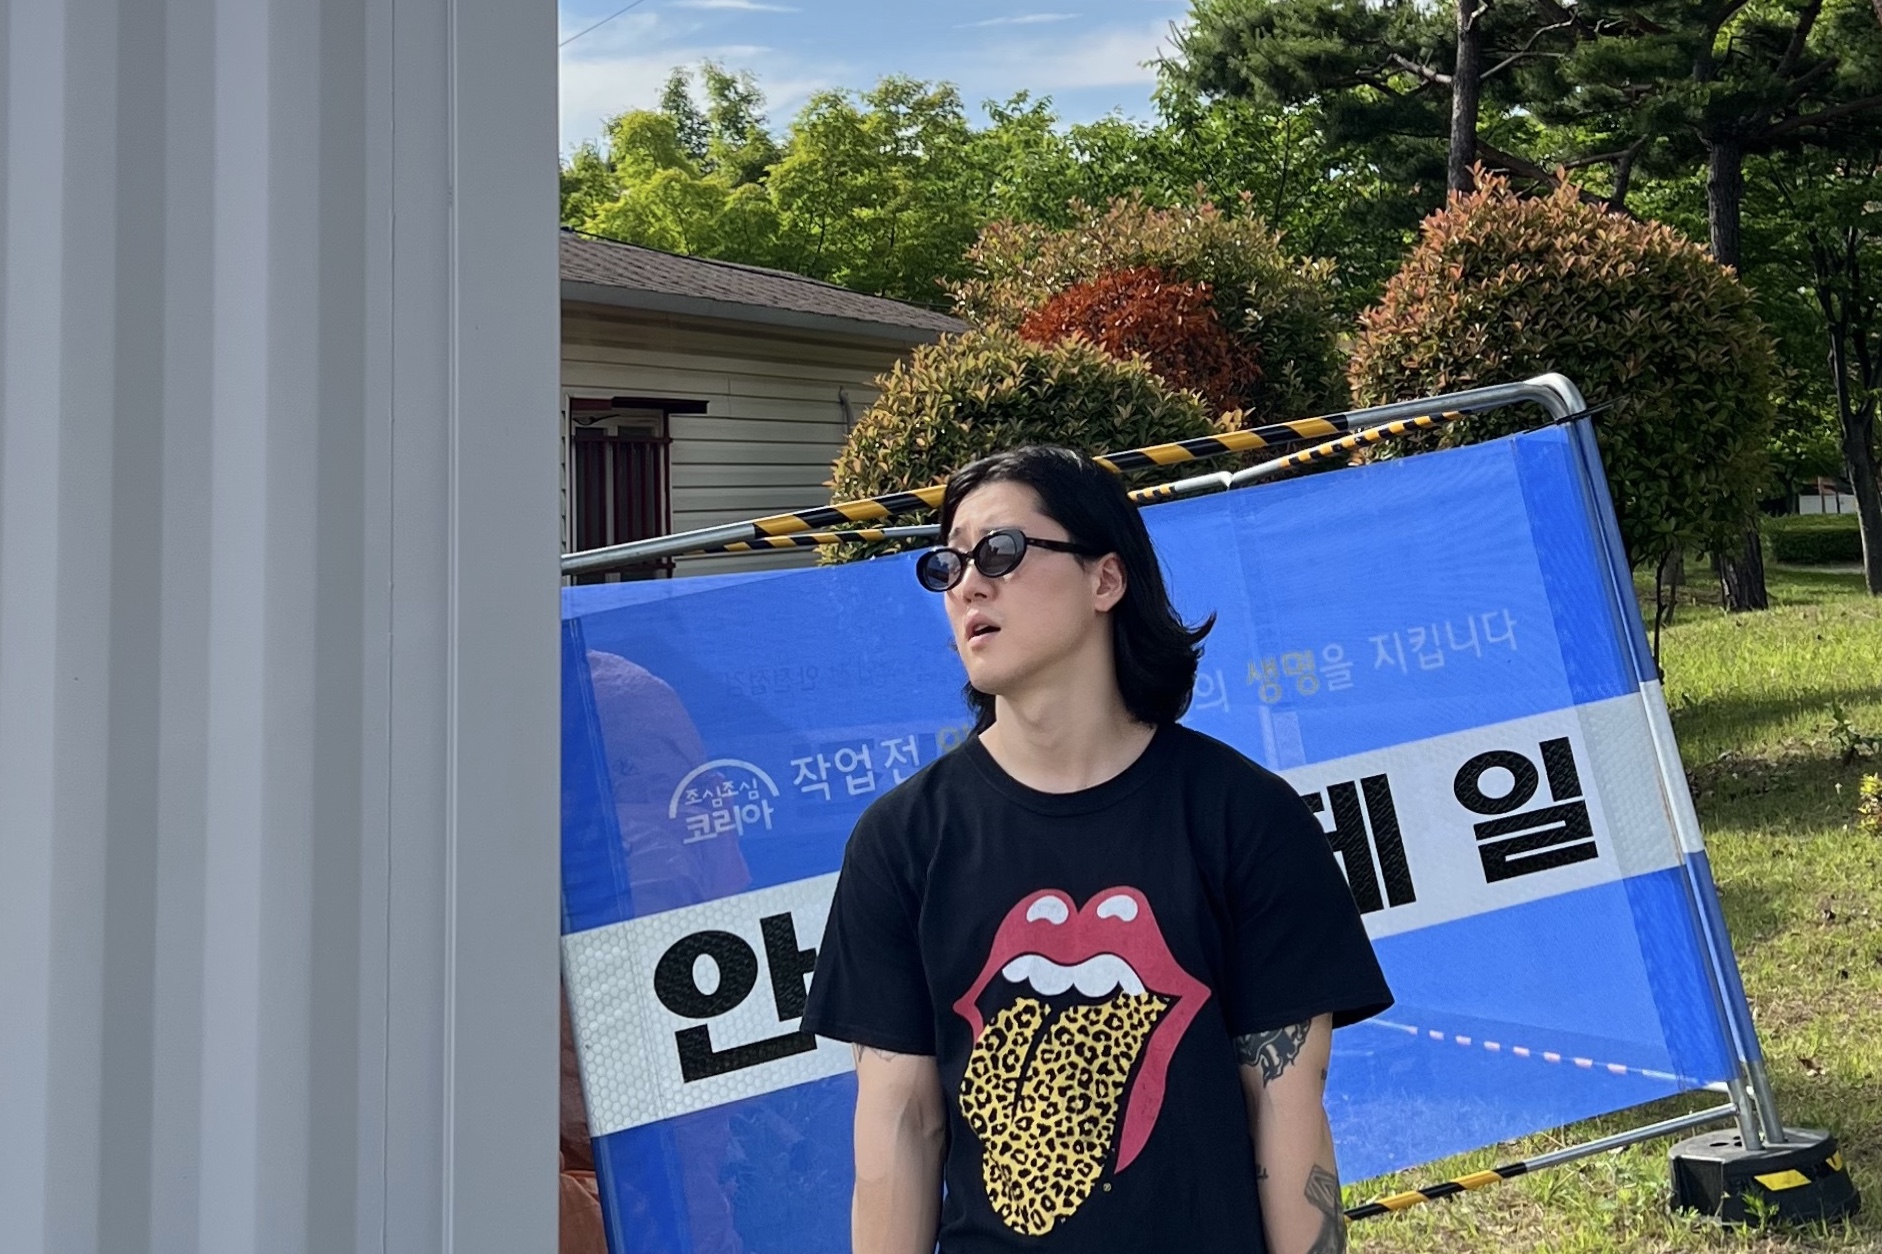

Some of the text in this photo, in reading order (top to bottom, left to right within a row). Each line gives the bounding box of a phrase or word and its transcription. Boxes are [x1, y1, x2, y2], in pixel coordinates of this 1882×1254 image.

[1246, 642, 1355, 704] 생명을
[1367, 607, 1518, 676] 지킵니다
[684, 777, 760, 808] 조심조심
[682, 799, 775, 845] 코리아
